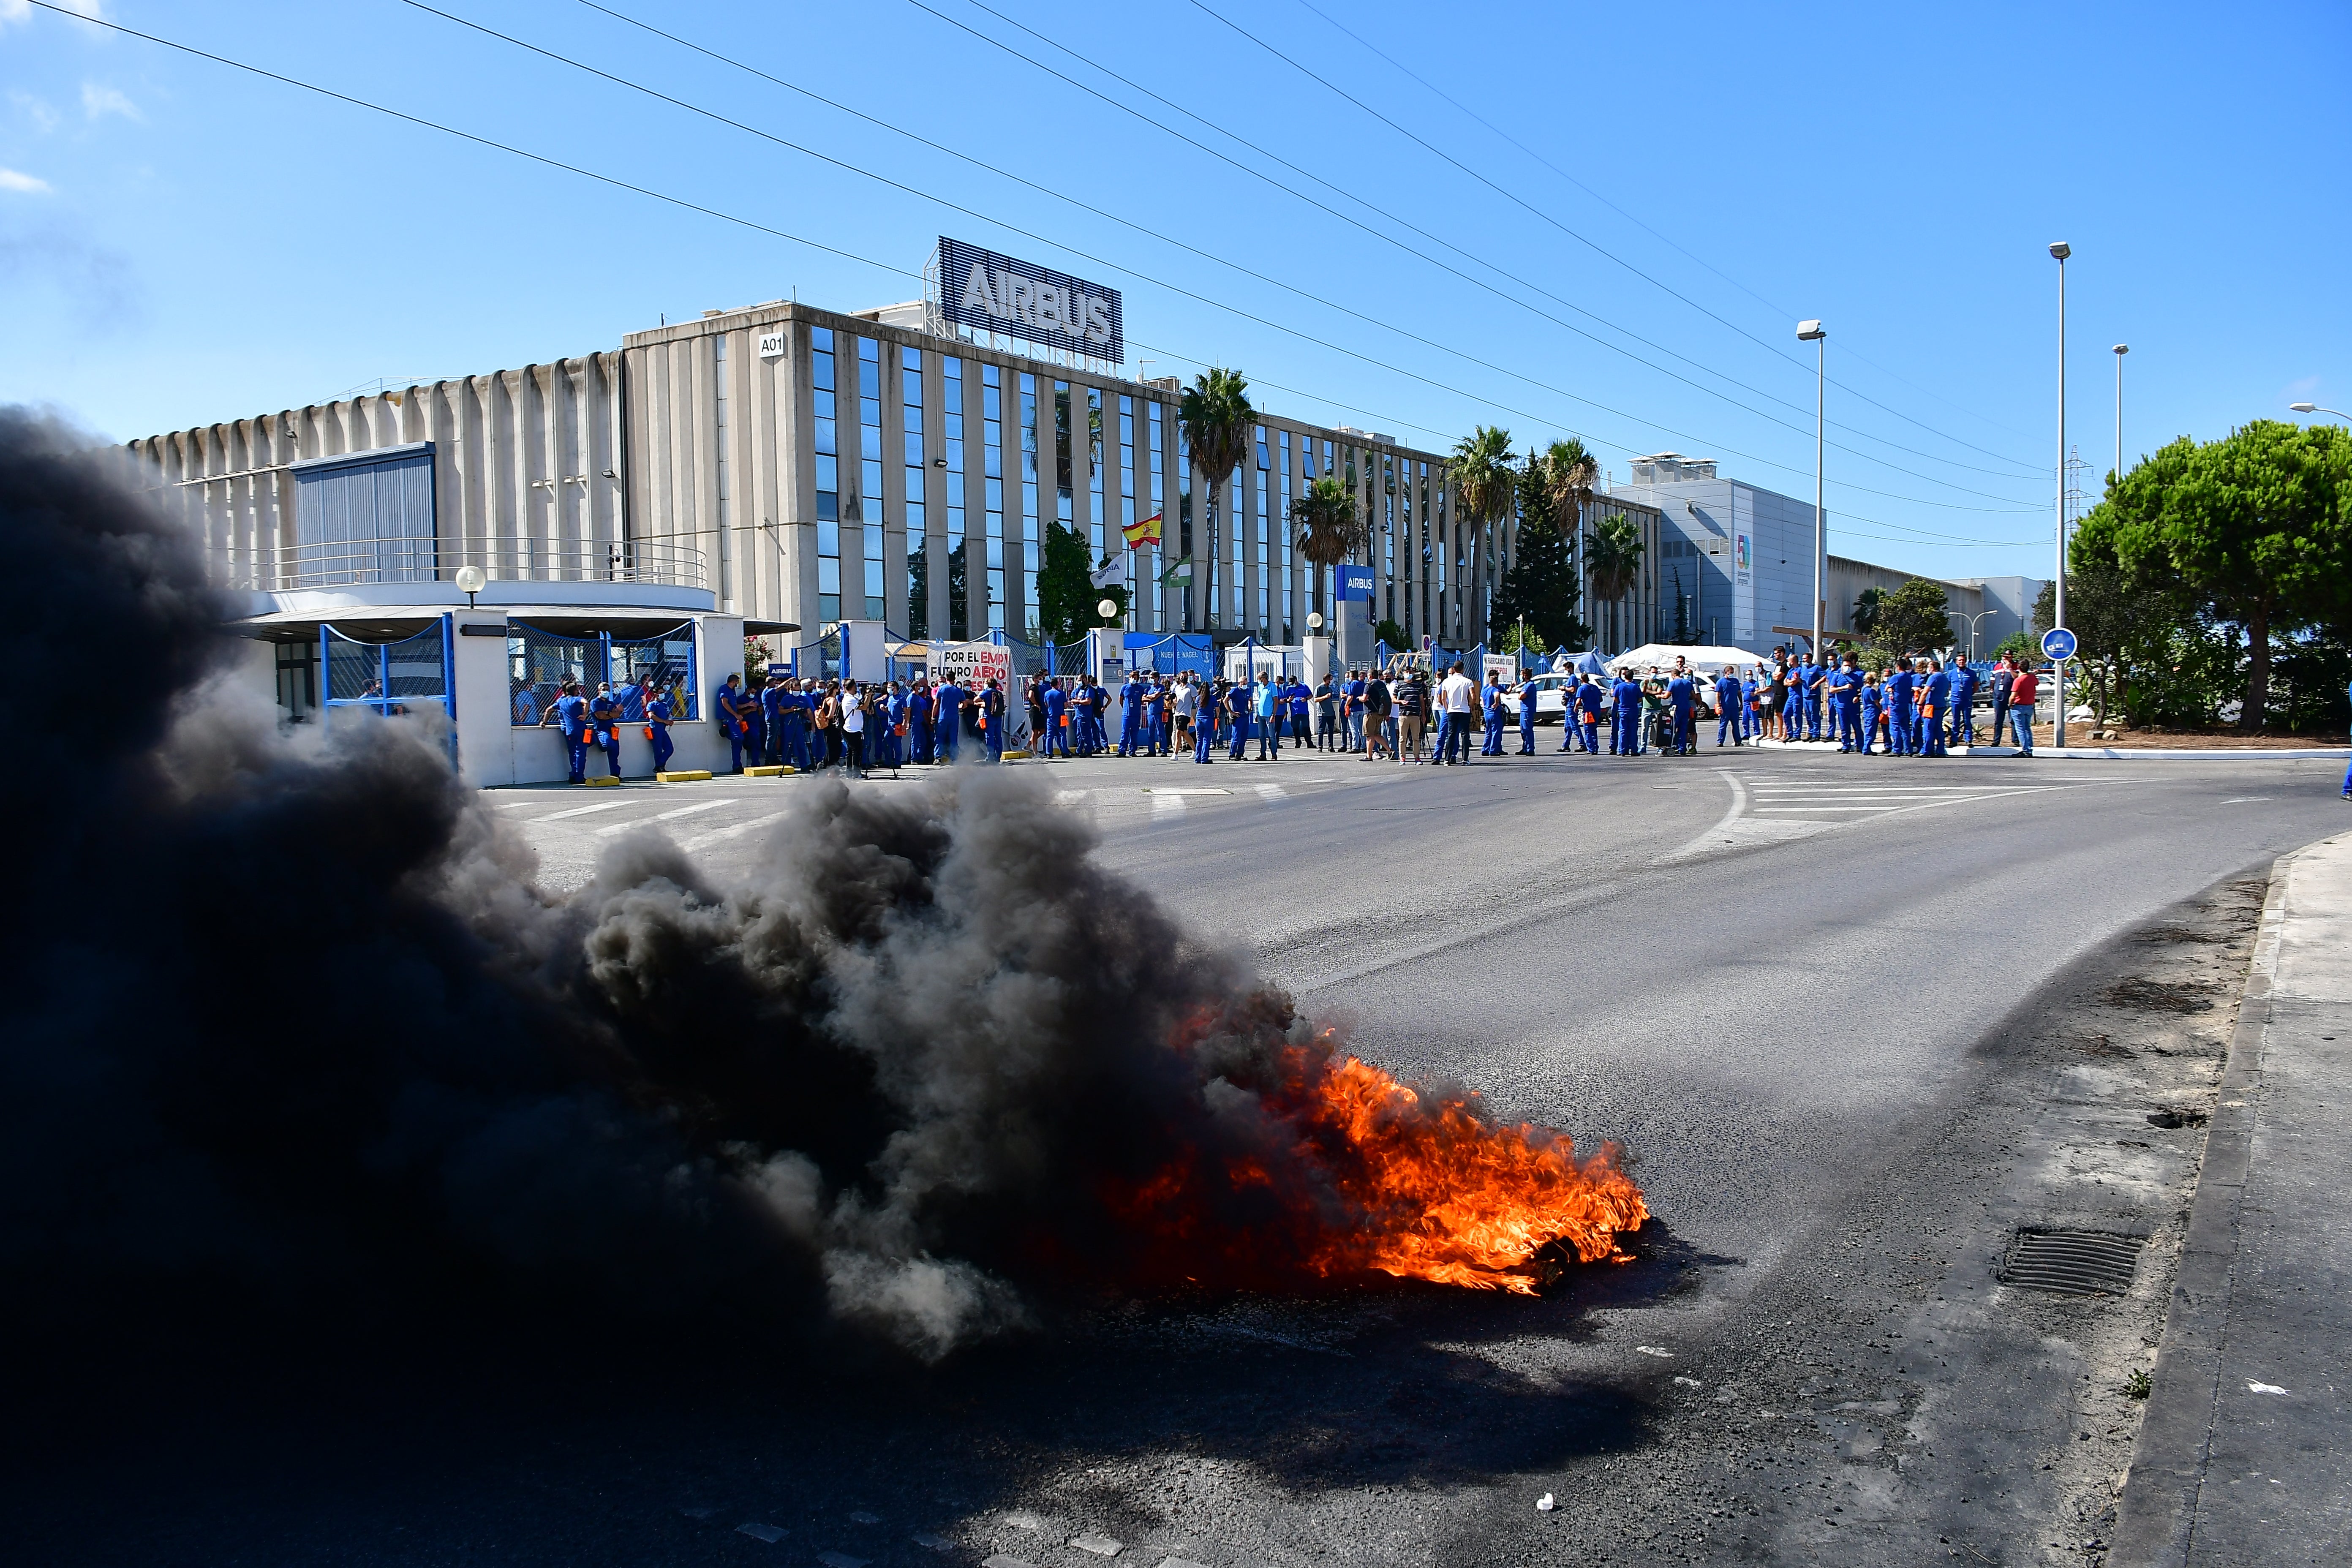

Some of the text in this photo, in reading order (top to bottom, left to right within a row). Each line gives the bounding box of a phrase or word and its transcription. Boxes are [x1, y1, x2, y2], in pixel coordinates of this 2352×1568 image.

[961, 263, 1111, 343] AIRBUS
[762, 337, 781, 352] A01
[1348, 577, 1372, 590] AIRBUS
[945, 652, 964, 662] POR
[968, 652, 979, 662] EL
[931, 667, 971, 677] FUTURO
